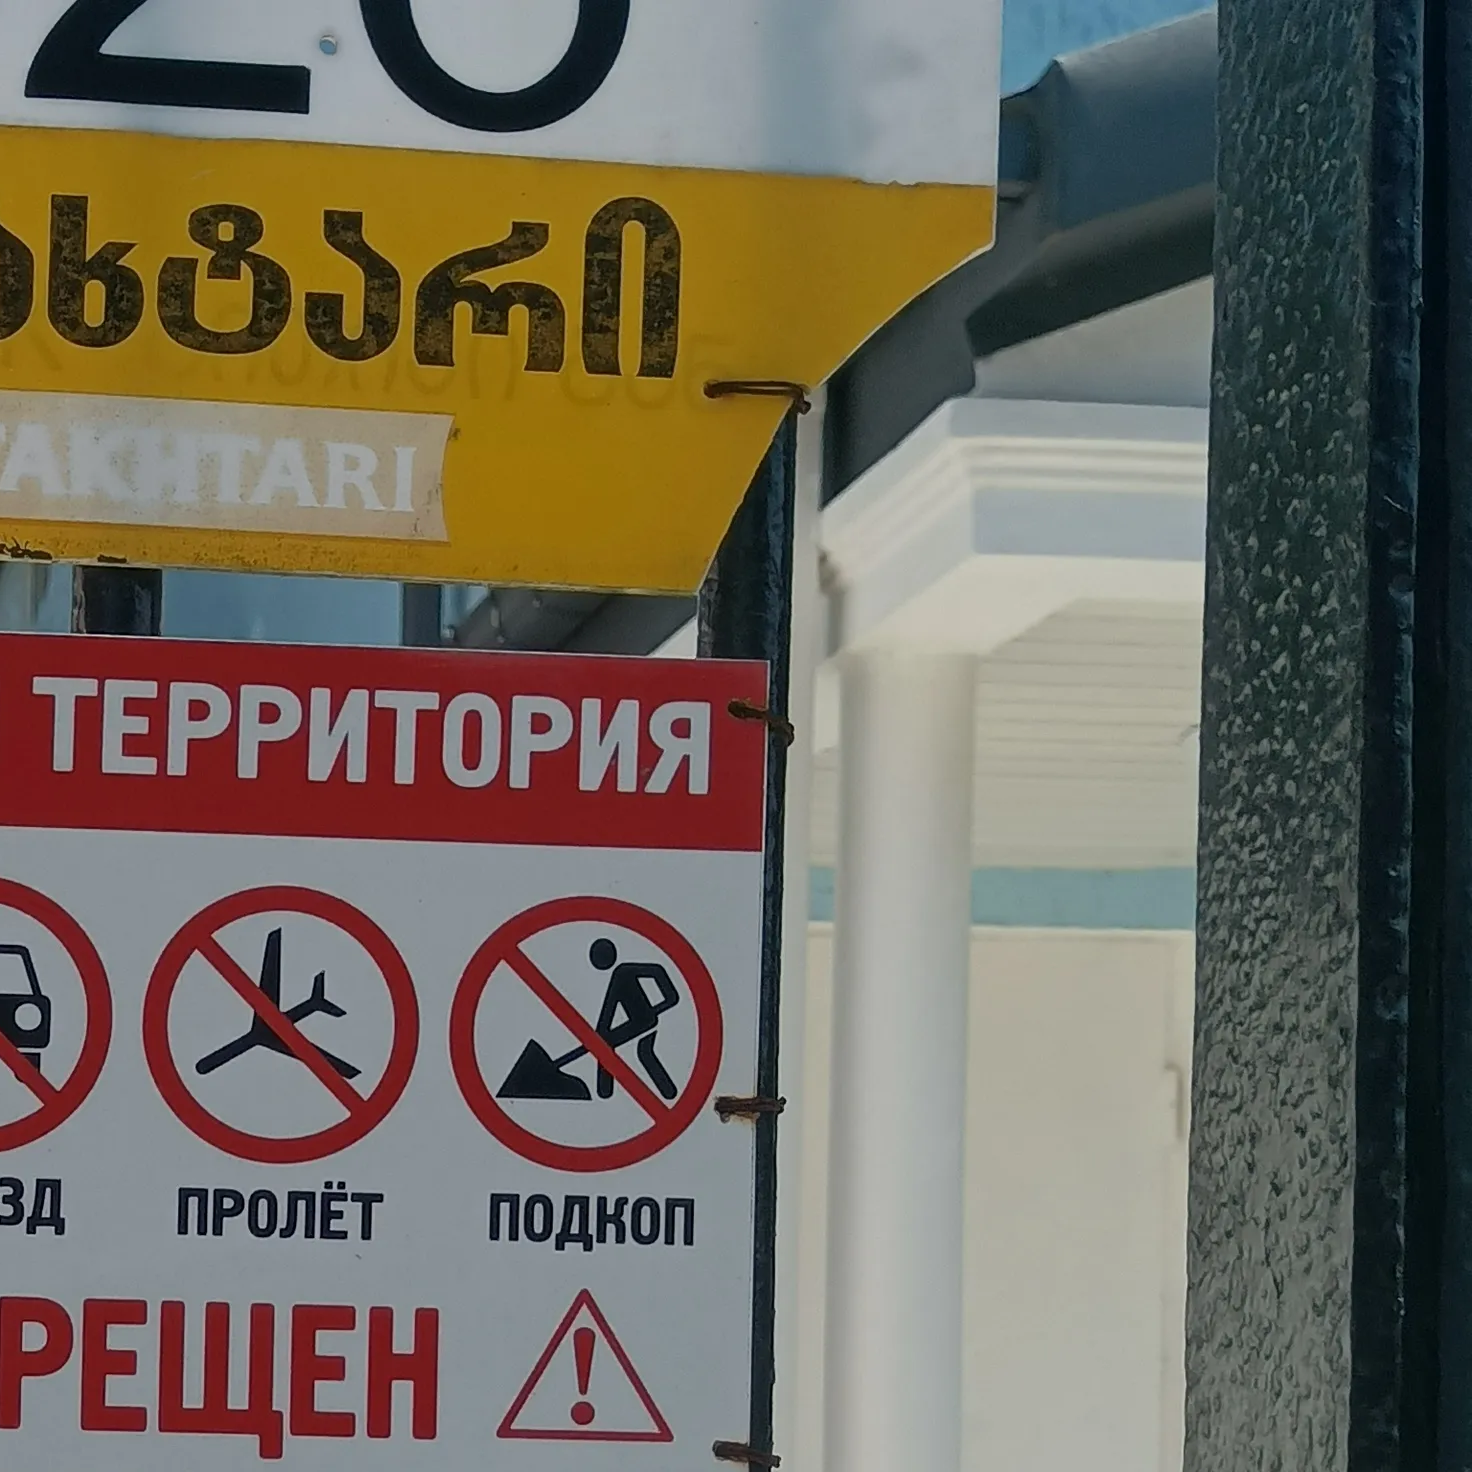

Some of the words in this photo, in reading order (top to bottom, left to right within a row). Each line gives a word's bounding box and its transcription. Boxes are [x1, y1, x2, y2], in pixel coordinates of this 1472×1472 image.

[32, 675, 711, 795] ТЕРРИТОРИЯ
[176, 1181, 384, 1241] ПРОЛЁТ
[489, 1193, 695, 1252] ПОДКОП
